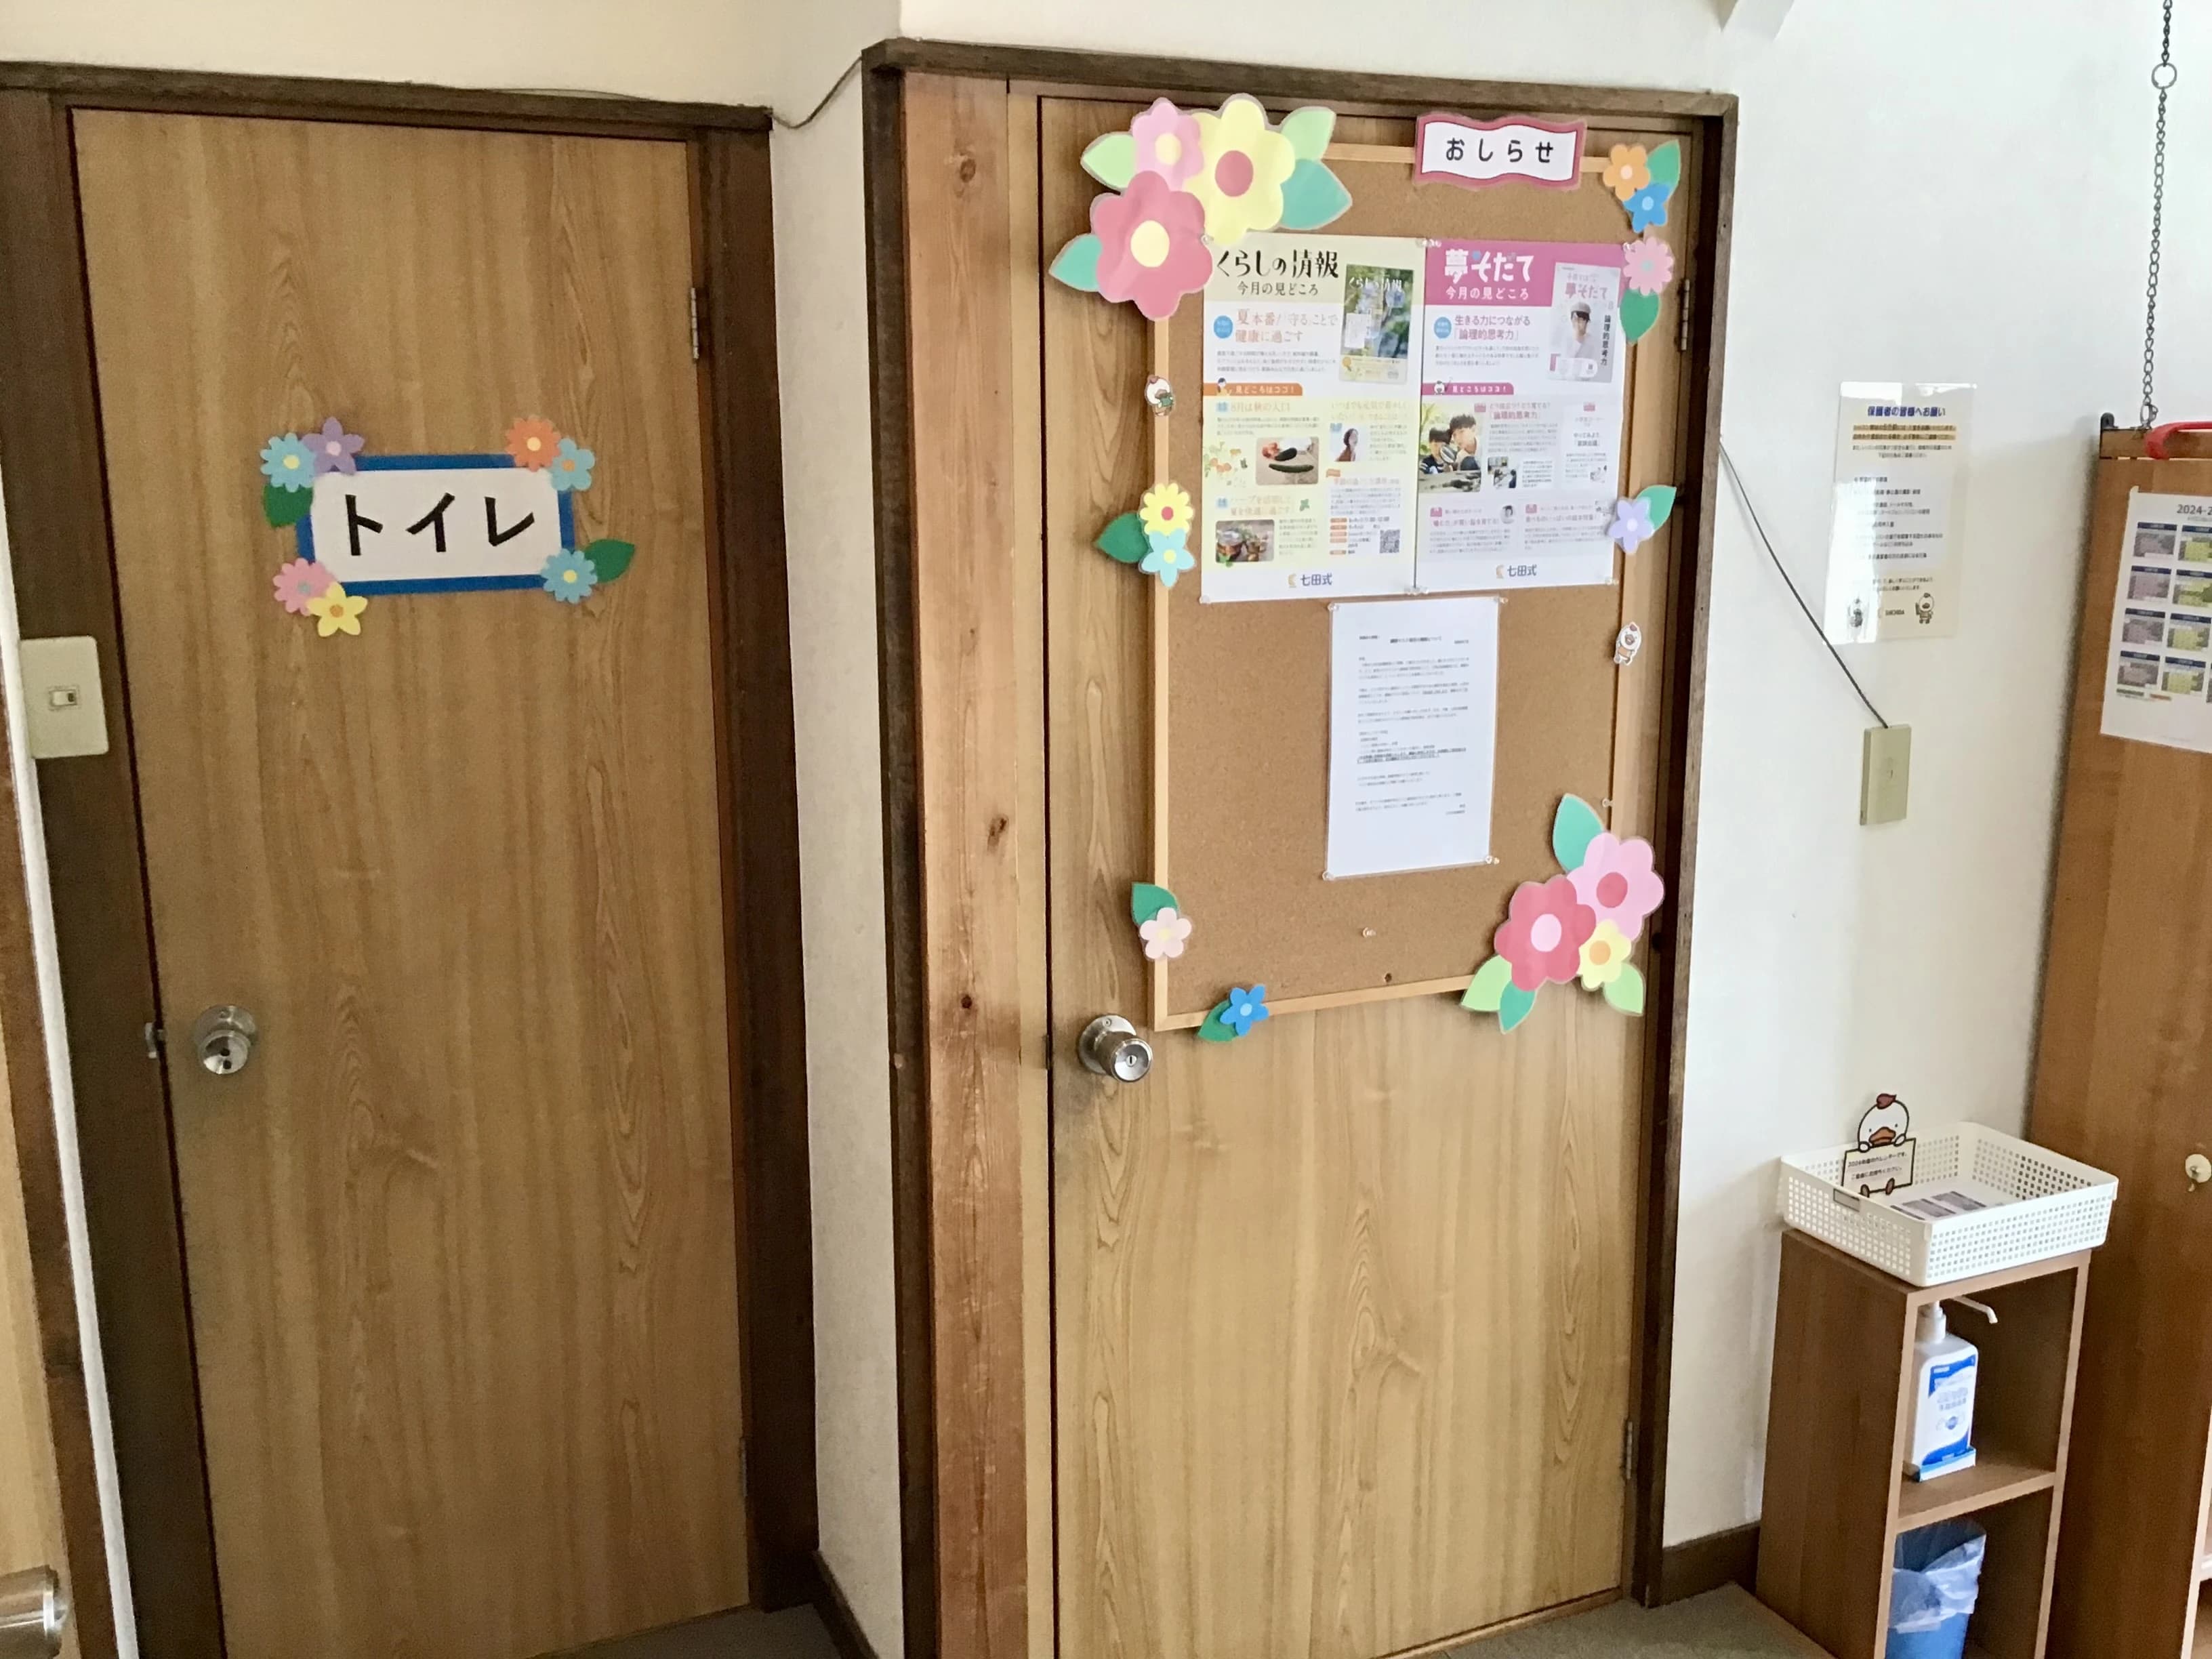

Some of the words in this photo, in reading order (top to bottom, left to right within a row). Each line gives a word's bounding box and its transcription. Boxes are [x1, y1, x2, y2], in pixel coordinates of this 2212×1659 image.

[1446, 138, 1554, 163] おしらせ
[1217, 249, 1339, 279] くらしの情報
[1444, 248, 1534, 283] 夢そだて
[1237, 281, 1319, 296] 今月の見どころ
[1446, 286, 1530, 300] 今月の見どころ
[1454, 314, 1531, 326] 生きる力につながる
[345, 492, 535, 556] トイレ
[1507, 564, 1538, 577] 七田式
[1300, 573, 1333, 587] 七田式
